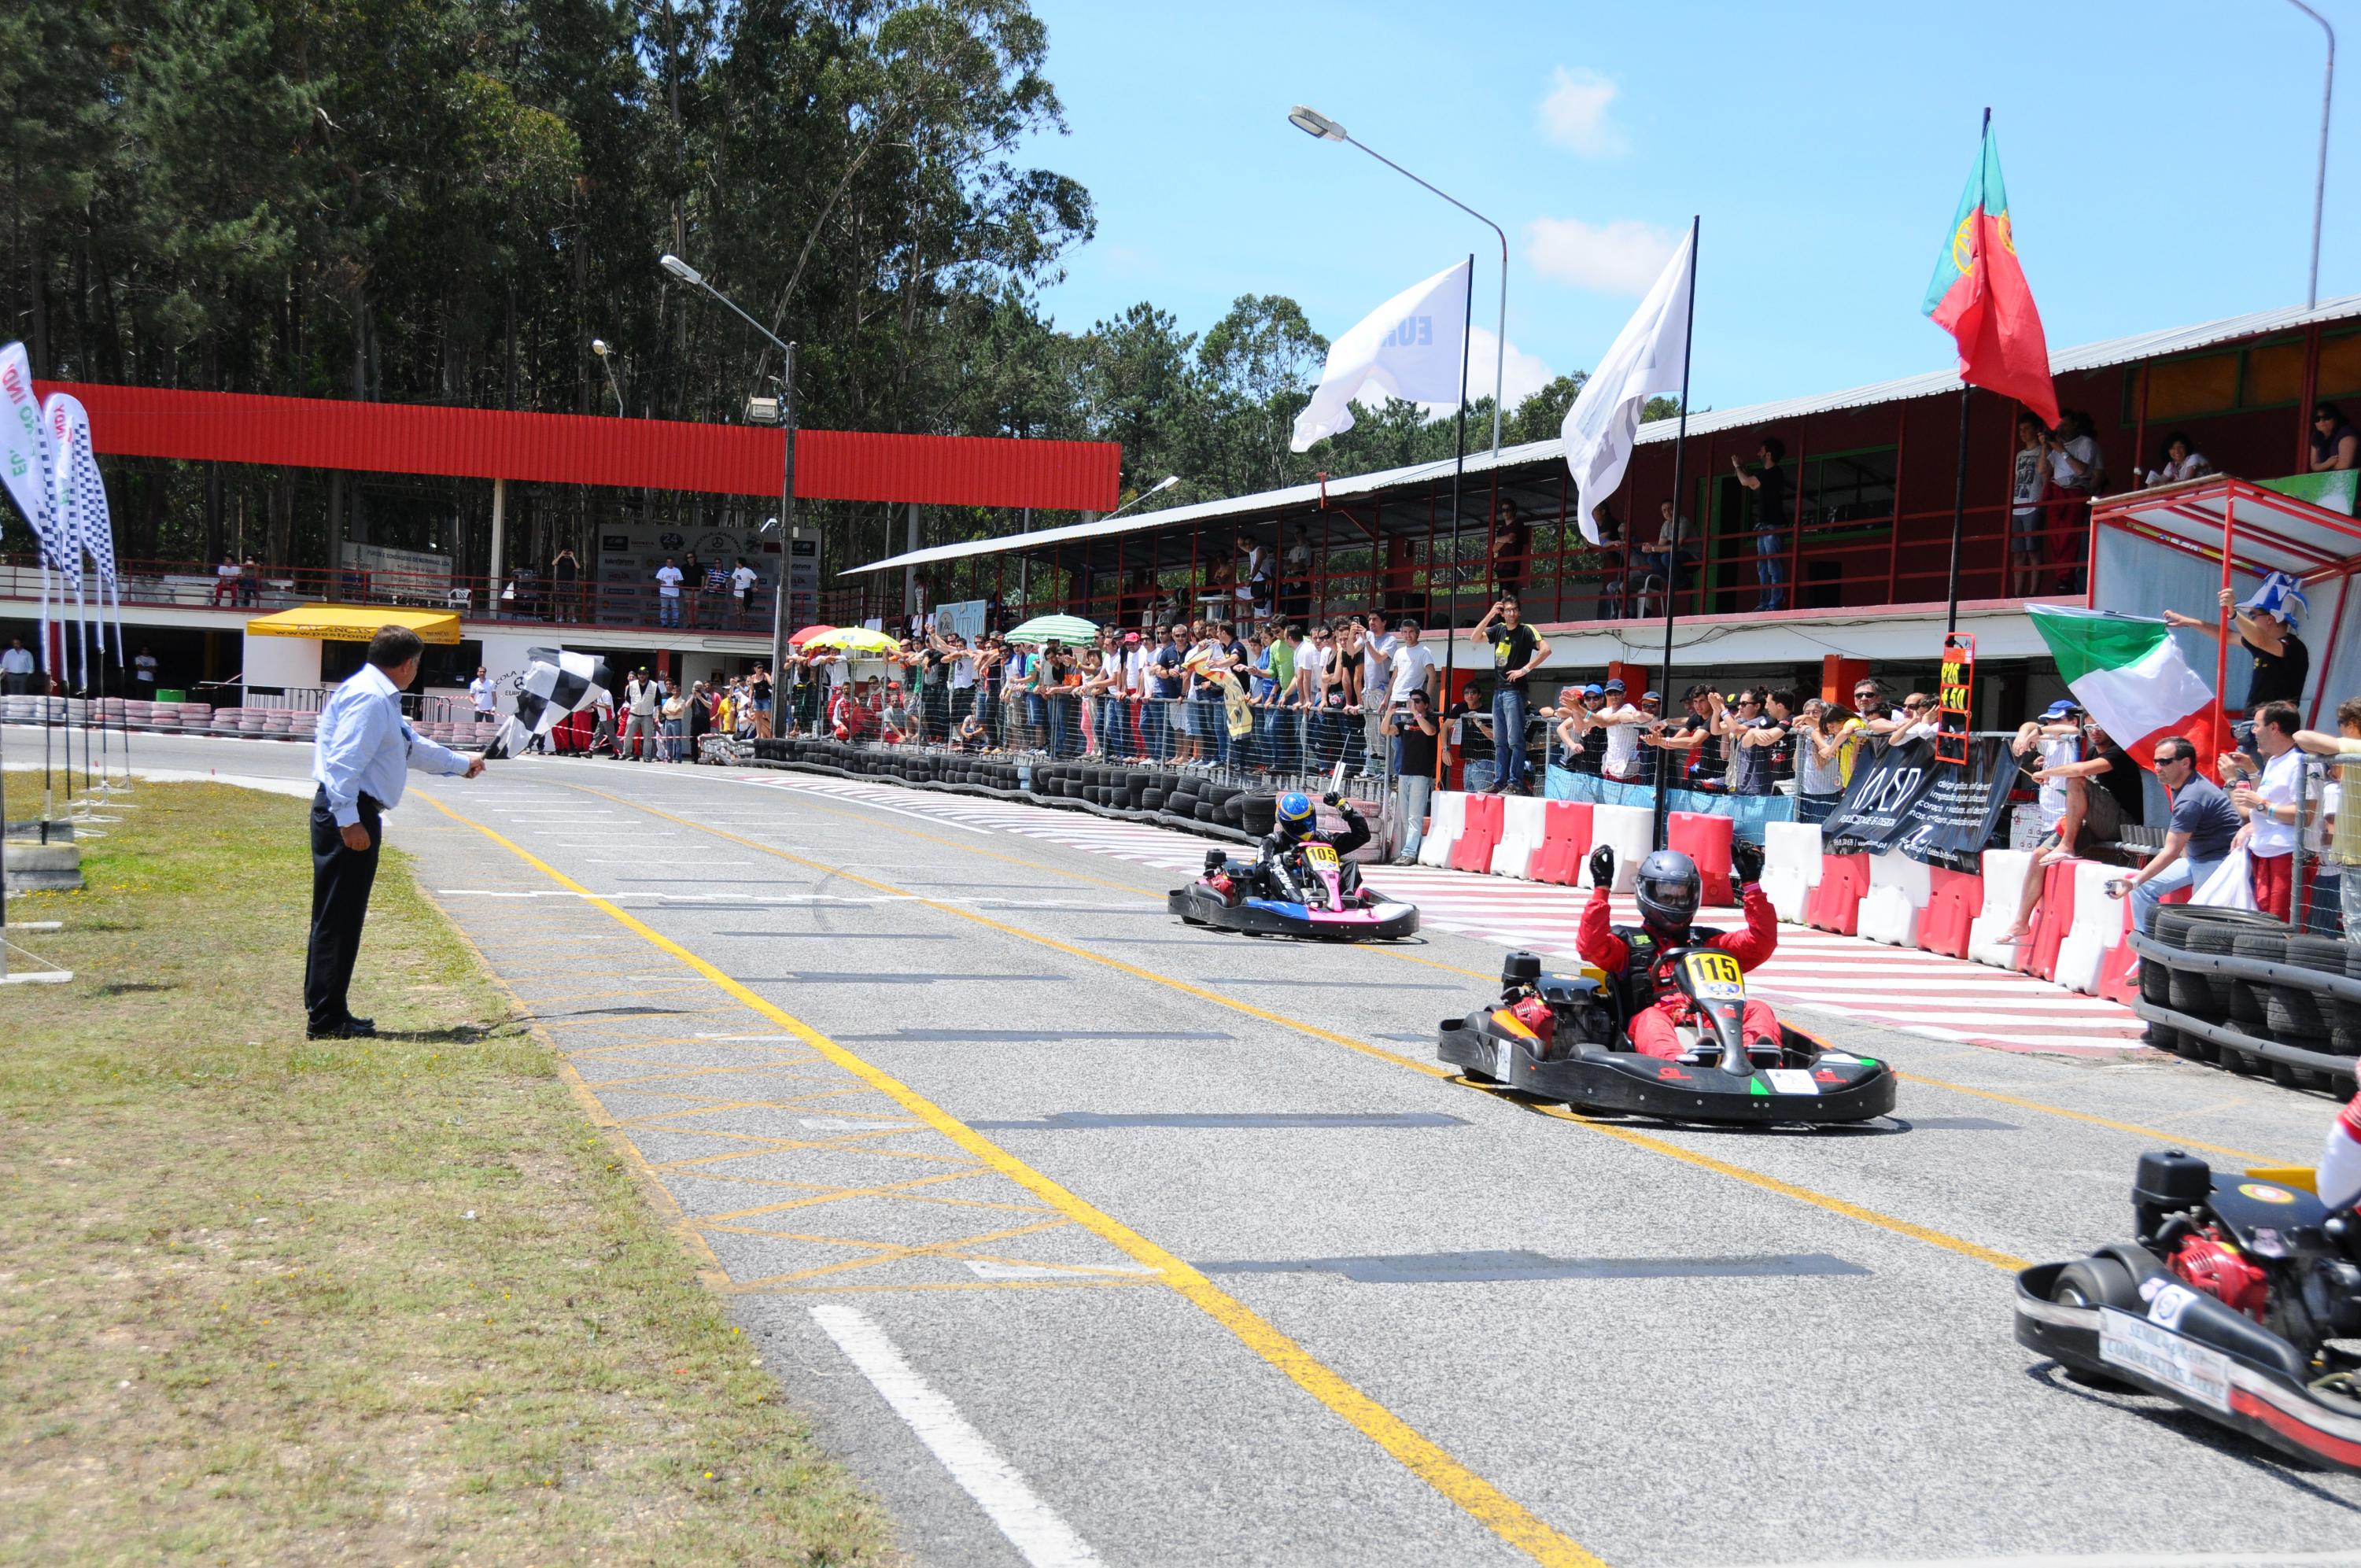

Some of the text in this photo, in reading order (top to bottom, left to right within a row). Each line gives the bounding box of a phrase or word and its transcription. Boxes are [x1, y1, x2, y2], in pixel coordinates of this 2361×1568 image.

[1941, 662, 1961, 684] P26
[1309, 848, 1337, 862] 105
[1692, 957, 1737, 982] 115
